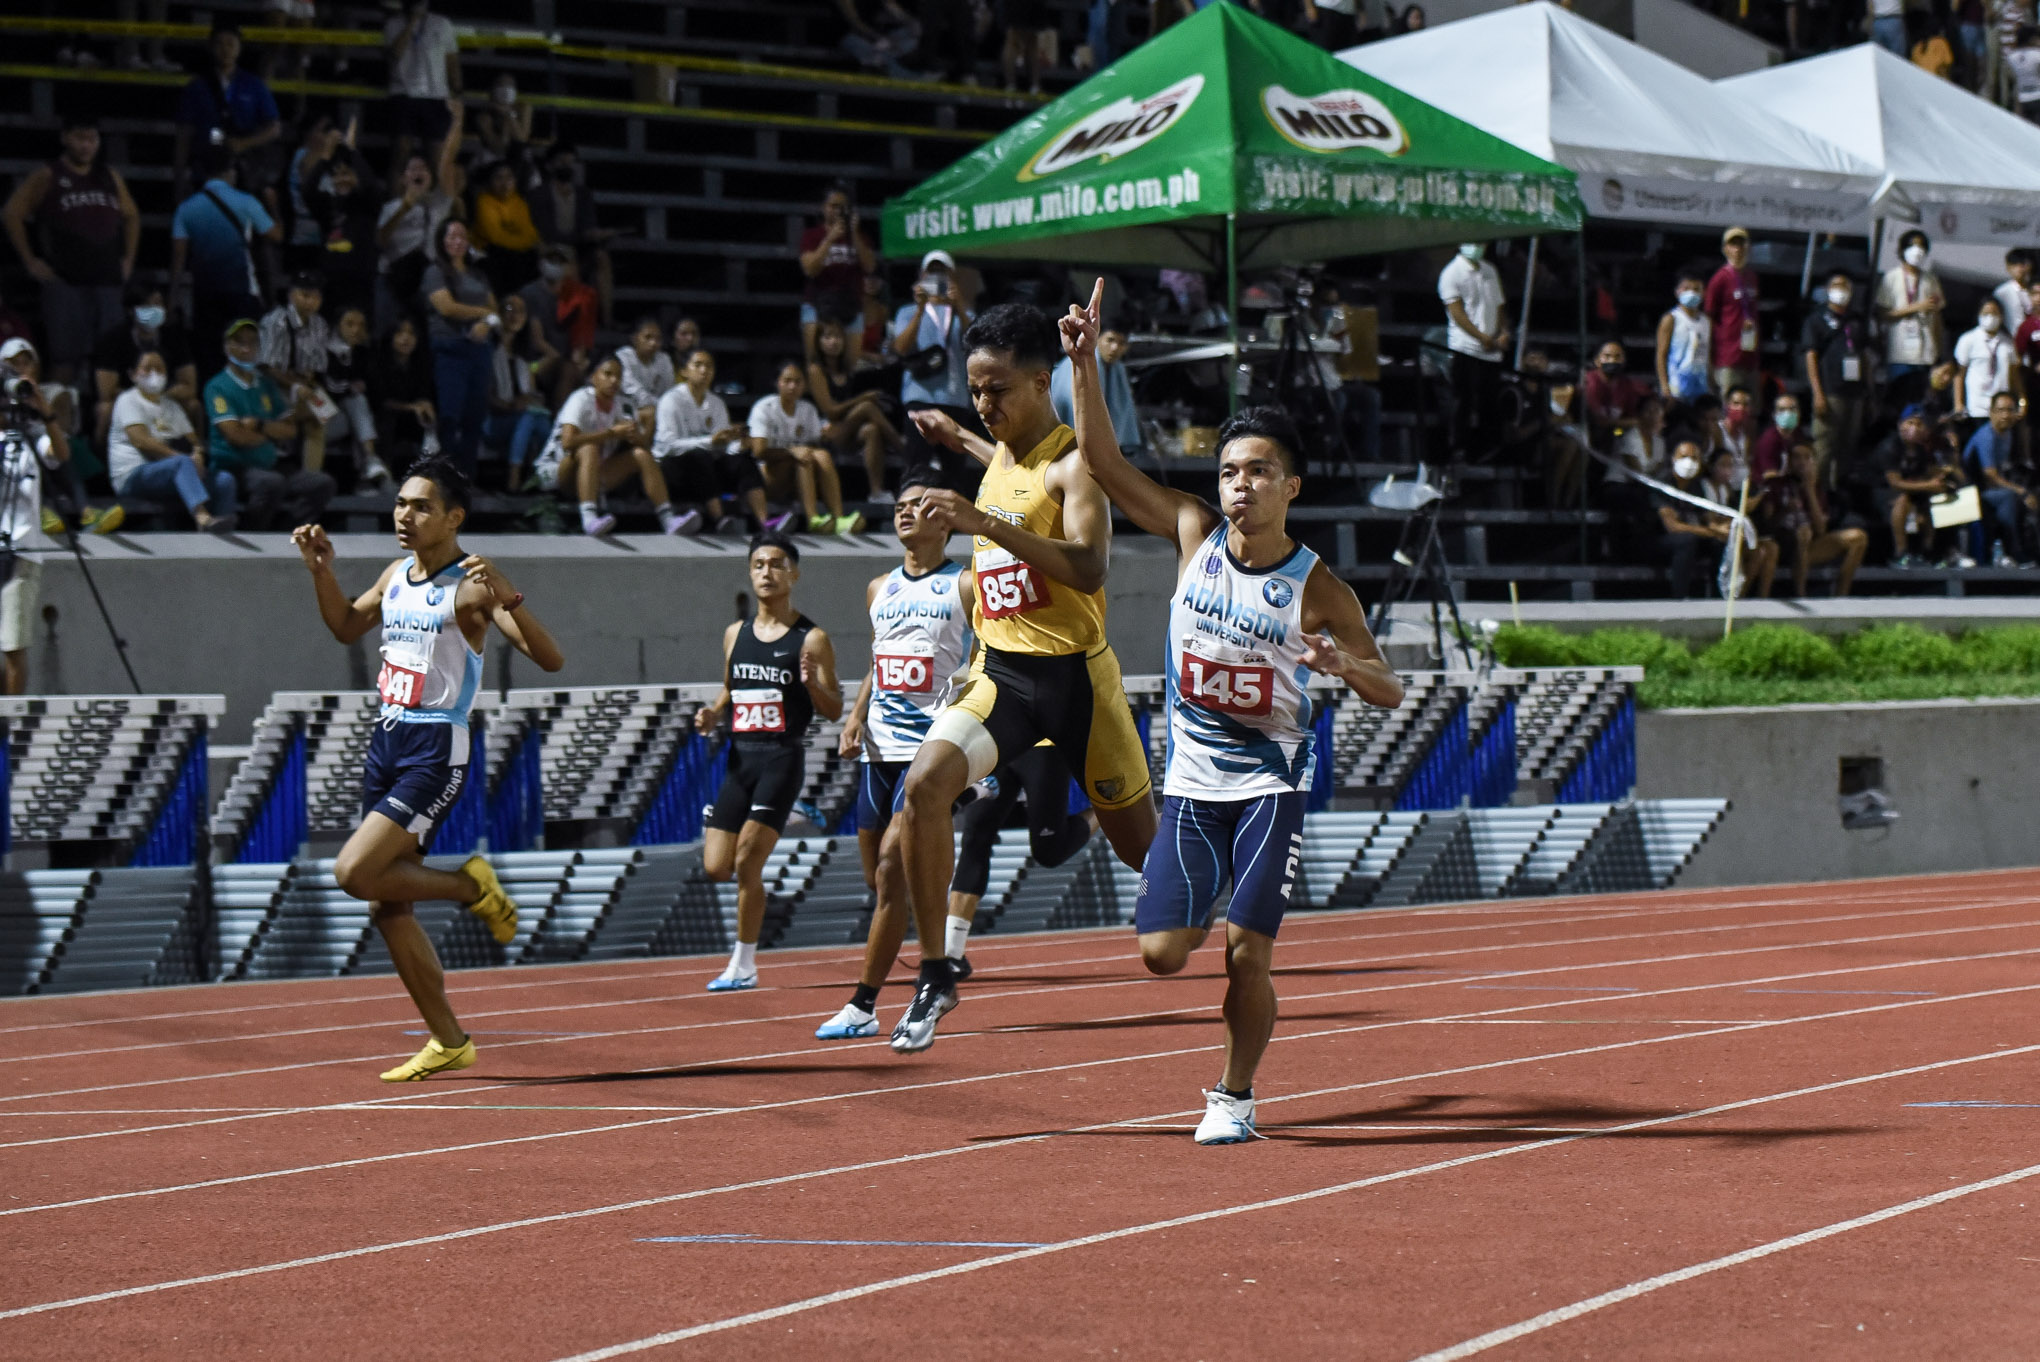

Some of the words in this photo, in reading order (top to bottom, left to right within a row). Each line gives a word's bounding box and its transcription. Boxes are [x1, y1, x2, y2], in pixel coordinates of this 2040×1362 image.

[1048, 103, 1179, 165] MILO
[1276, 107, 1391, 139] MILO
[905, 203, 967, 240] visit:
[973, 167, 1200, 231] www.milo.com.ph
[982, 568, 1038, 611] 851
[876, 599, 953, 621] ADAMSON
[1182, 582, 1289, 647] ADAMSON
[1196, 617, 1258, 651] UNIVERSITY
[733, 663, 793, 685] ATENEO
[878, 658, 926, 687] 150
[1188, 662, 1262, 708] 145
[1552, 671, 1586, 683] UCS
[74, 700, 129, 714] UCS
[592, 690, 640, 704] UCS
[734, 704, 782, 729] 248
[427, 768, 463, 817] FALCONS
